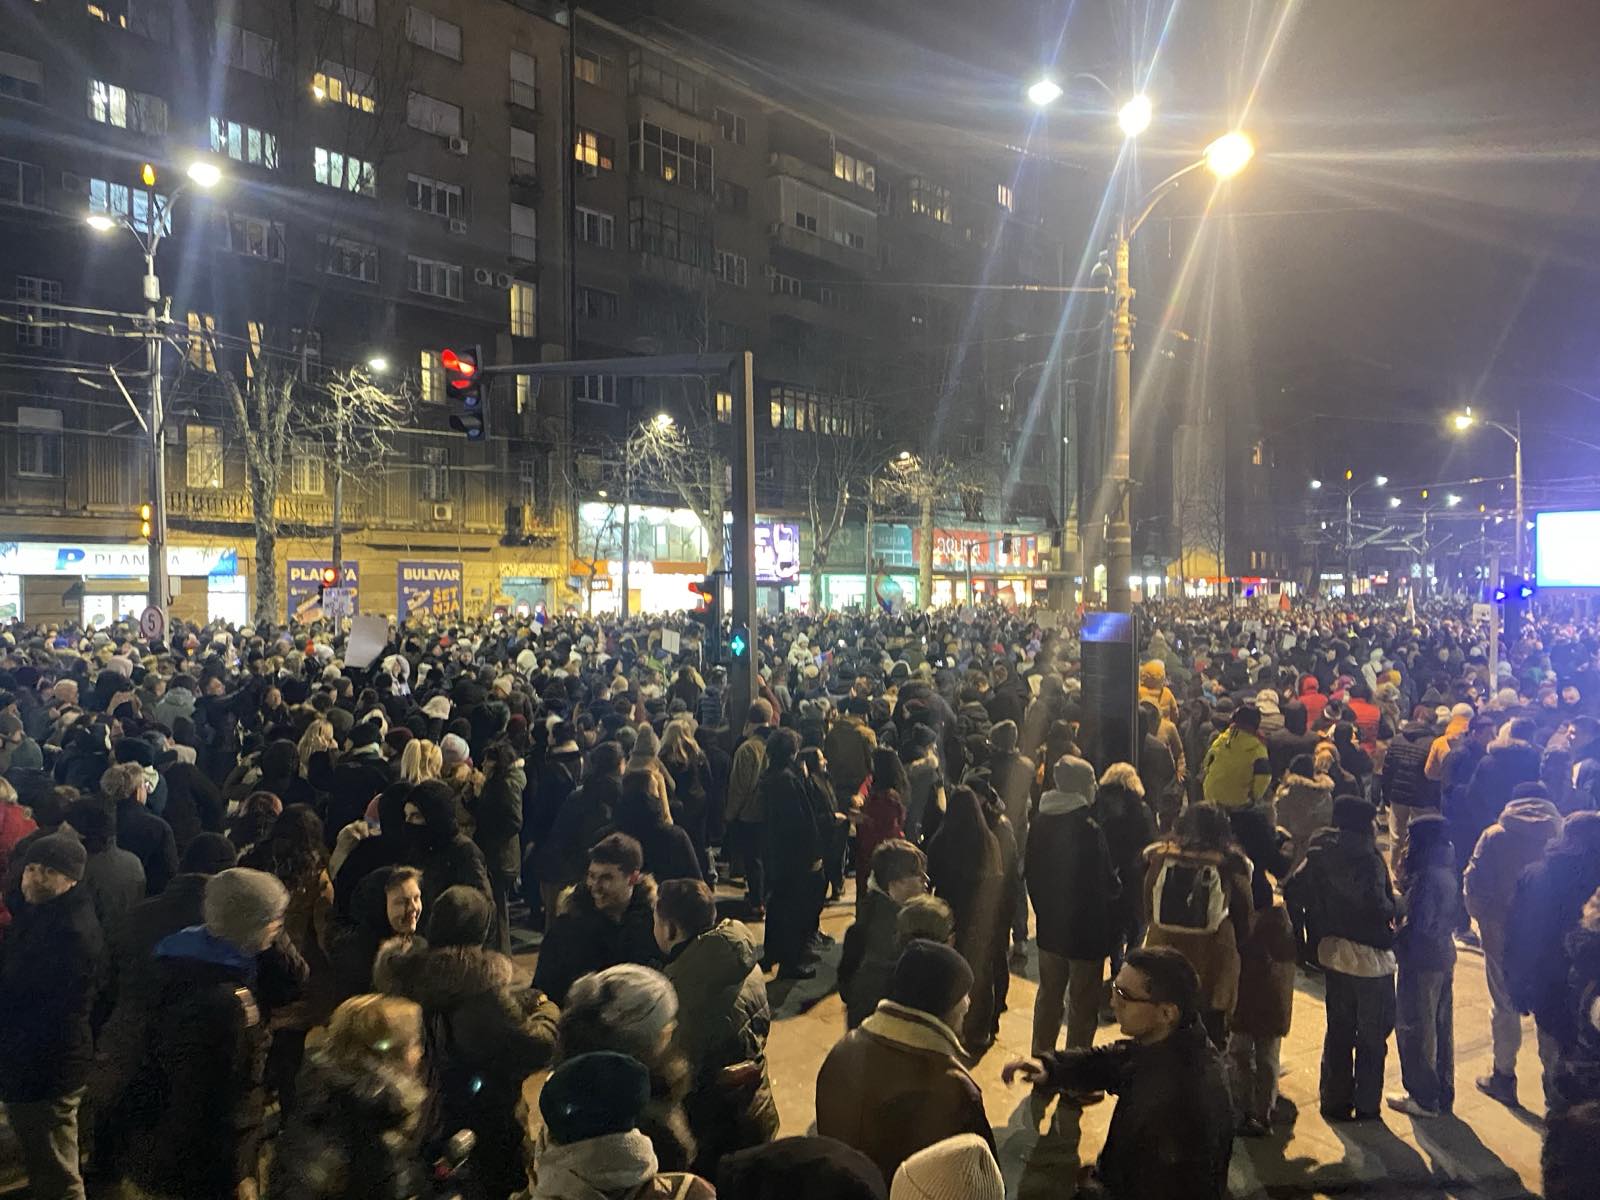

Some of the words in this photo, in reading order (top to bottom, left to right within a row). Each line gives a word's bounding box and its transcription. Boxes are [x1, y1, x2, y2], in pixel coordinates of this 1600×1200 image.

[94, 553, 180, 565] PLANA
[290, 567, 357, 581] PLAA
[403, 567, 460, 581] BULEVAR
